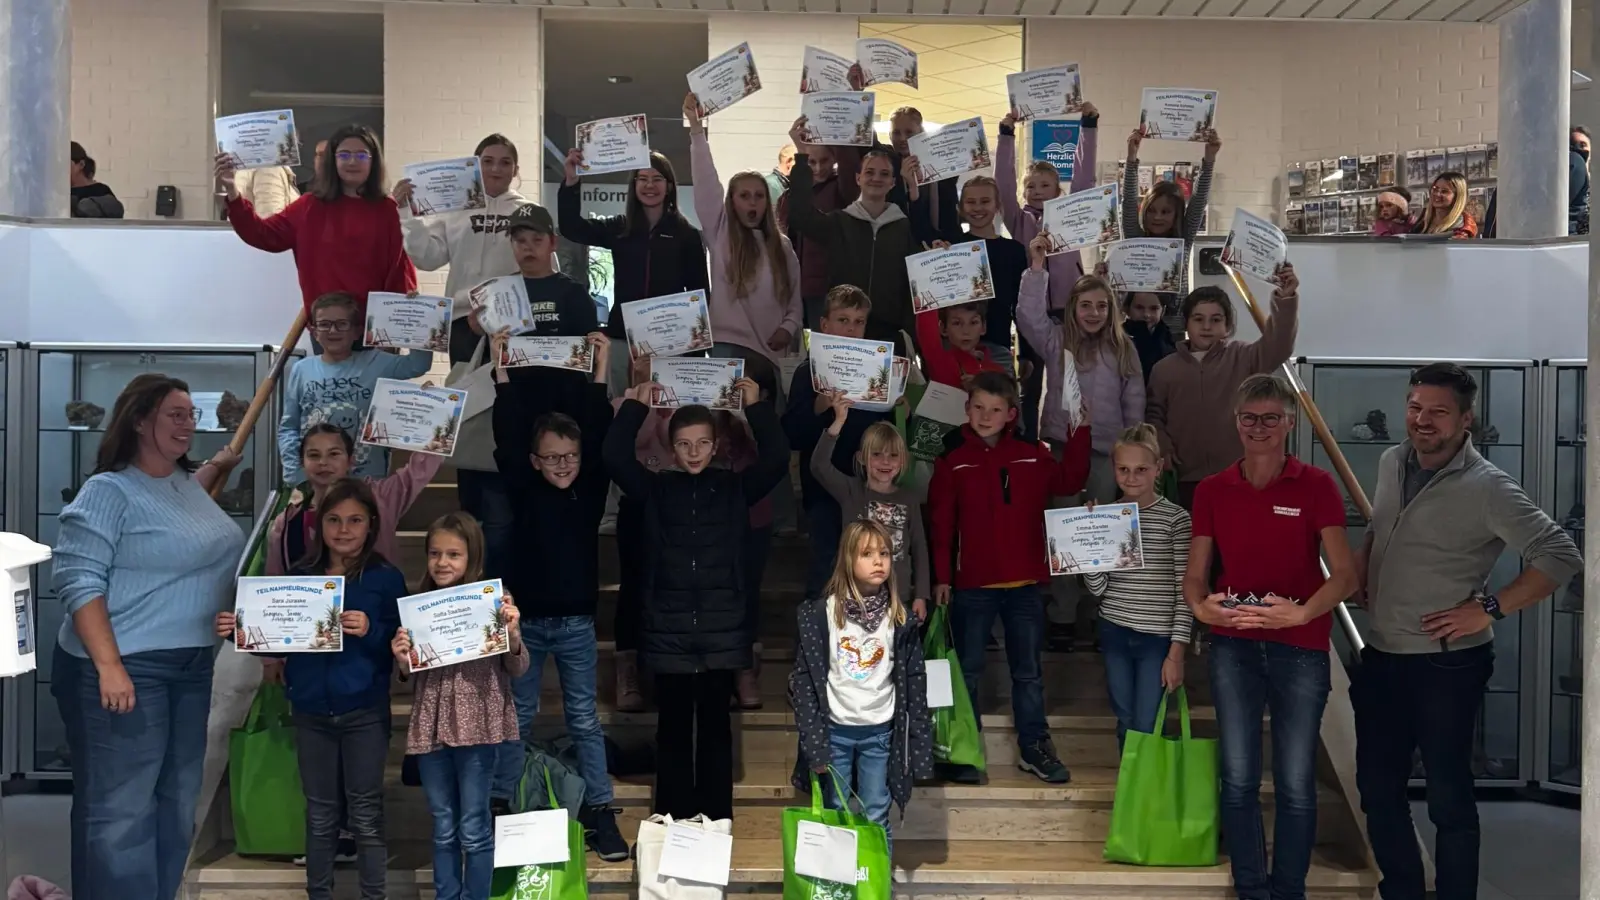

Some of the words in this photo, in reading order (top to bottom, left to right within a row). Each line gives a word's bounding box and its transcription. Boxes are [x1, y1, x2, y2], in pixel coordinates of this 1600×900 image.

[534, 313, 560, 322] RISK
[256, 584, 324, 596] TEILNAHMEURKUNDE
[417, 594, 483, 613] TEILNAHMEURKUNDE
